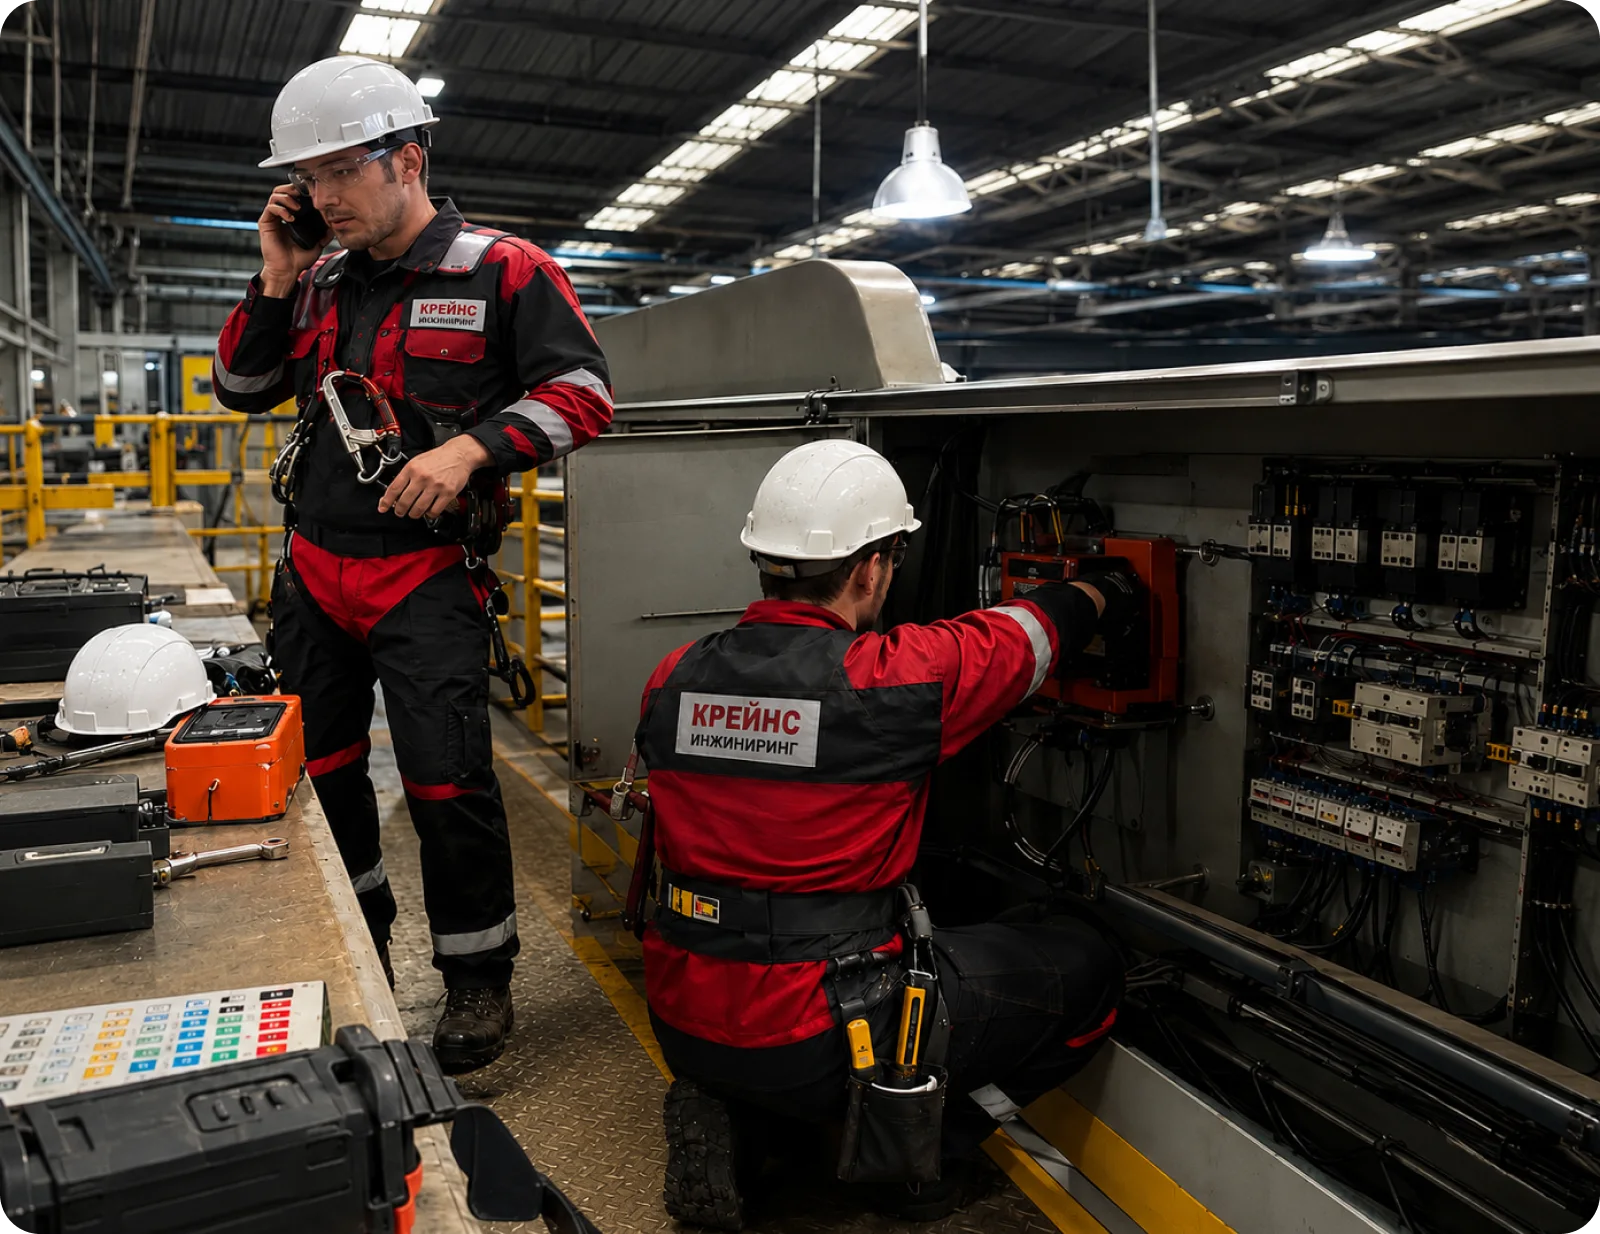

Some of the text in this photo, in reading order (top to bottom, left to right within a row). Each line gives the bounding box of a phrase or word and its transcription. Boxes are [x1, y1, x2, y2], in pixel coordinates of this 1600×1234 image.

[420, 301, 478, 317] КРЕЙНС
[692, 700, 801, 735] КРЕЙНС
[690, 733, 799, 756] ИНЖИНИРИНГ
